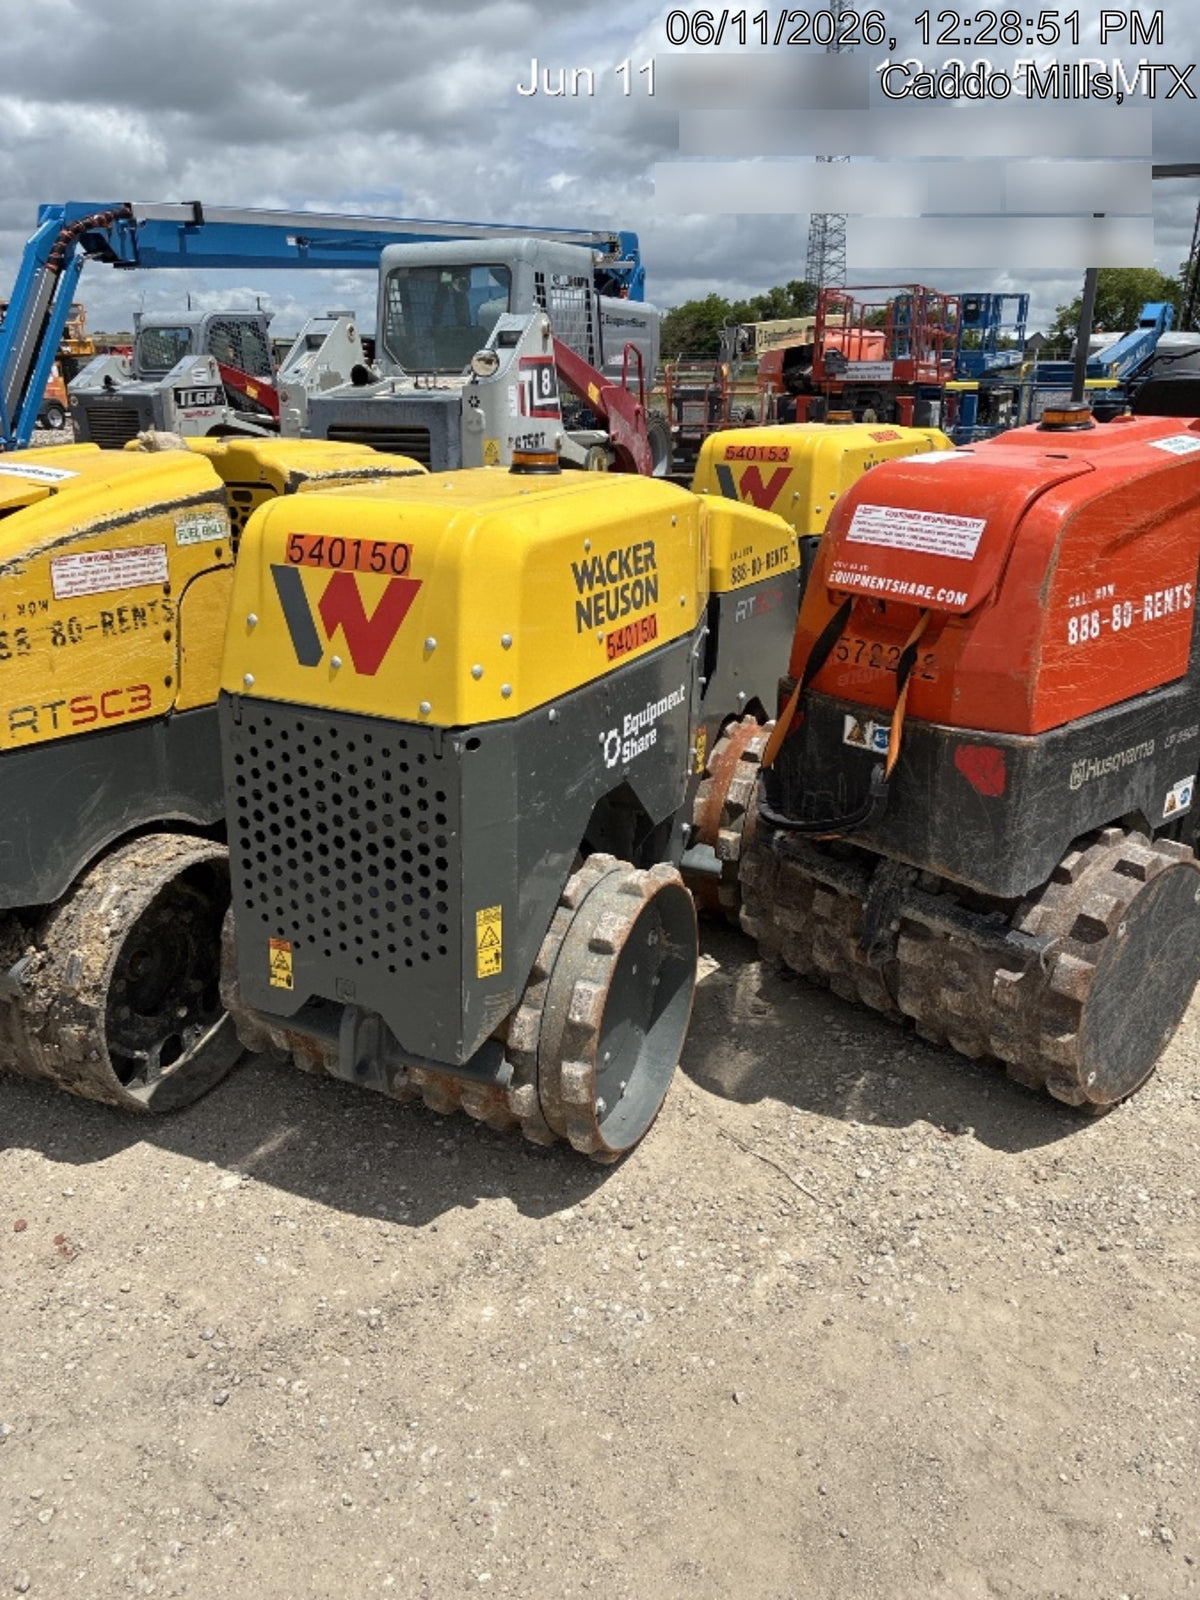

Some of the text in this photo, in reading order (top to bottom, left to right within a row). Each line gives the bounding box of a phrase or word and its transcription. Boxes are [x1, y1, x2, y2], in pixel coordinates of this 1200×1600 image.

[725, 445, 790, 463] 540153
[288, 534, 411, 575] 540150
[570, 540, 657, 595] WACKER
[575, 574, 659, 634] NEUSON
[828, 570, 968, 607] EQUIPMENTSHARE.COM
[607, 613, 657, 660] 540150
[1067, 582, 1192, 645] 888-80-RENTS
[836, 637, 937, 680] 57222
[9, 683, 153, 738] RTSC3
[622, 684, 686, 737] Equipment
[621, 728, 657, 764] Share
